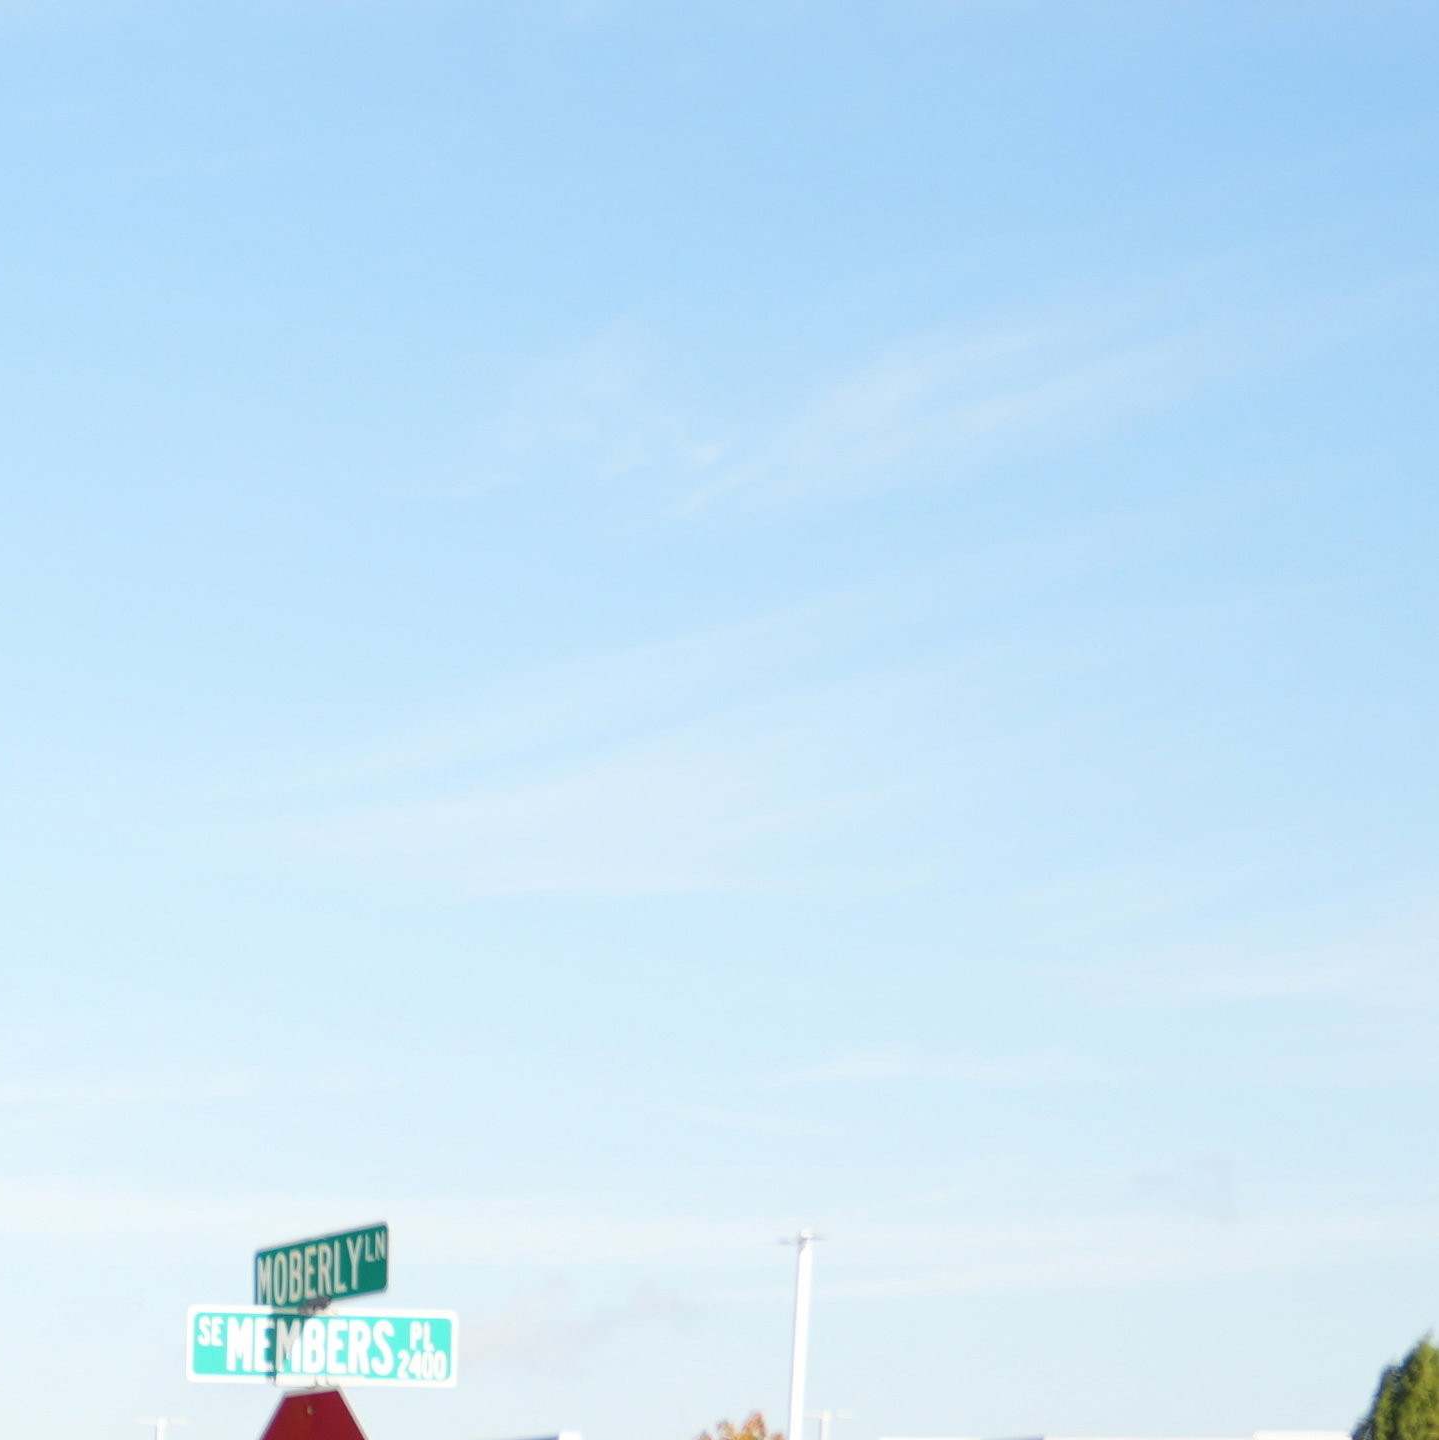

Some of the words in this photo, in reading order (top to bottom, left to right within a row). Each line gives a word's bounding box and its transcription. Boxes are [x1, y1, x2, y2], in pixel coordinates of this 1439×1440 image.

[257, 1234, 364, 1305] MOBERLY
[364, 1229, 385, 1262] LN
[198, 1315, 224, 1347] SE
[226, 1315, 395, 1376] MEMBERS
[409, 1321, 435, 1351] PL
[397, 1349, 447, 1381] 2400
